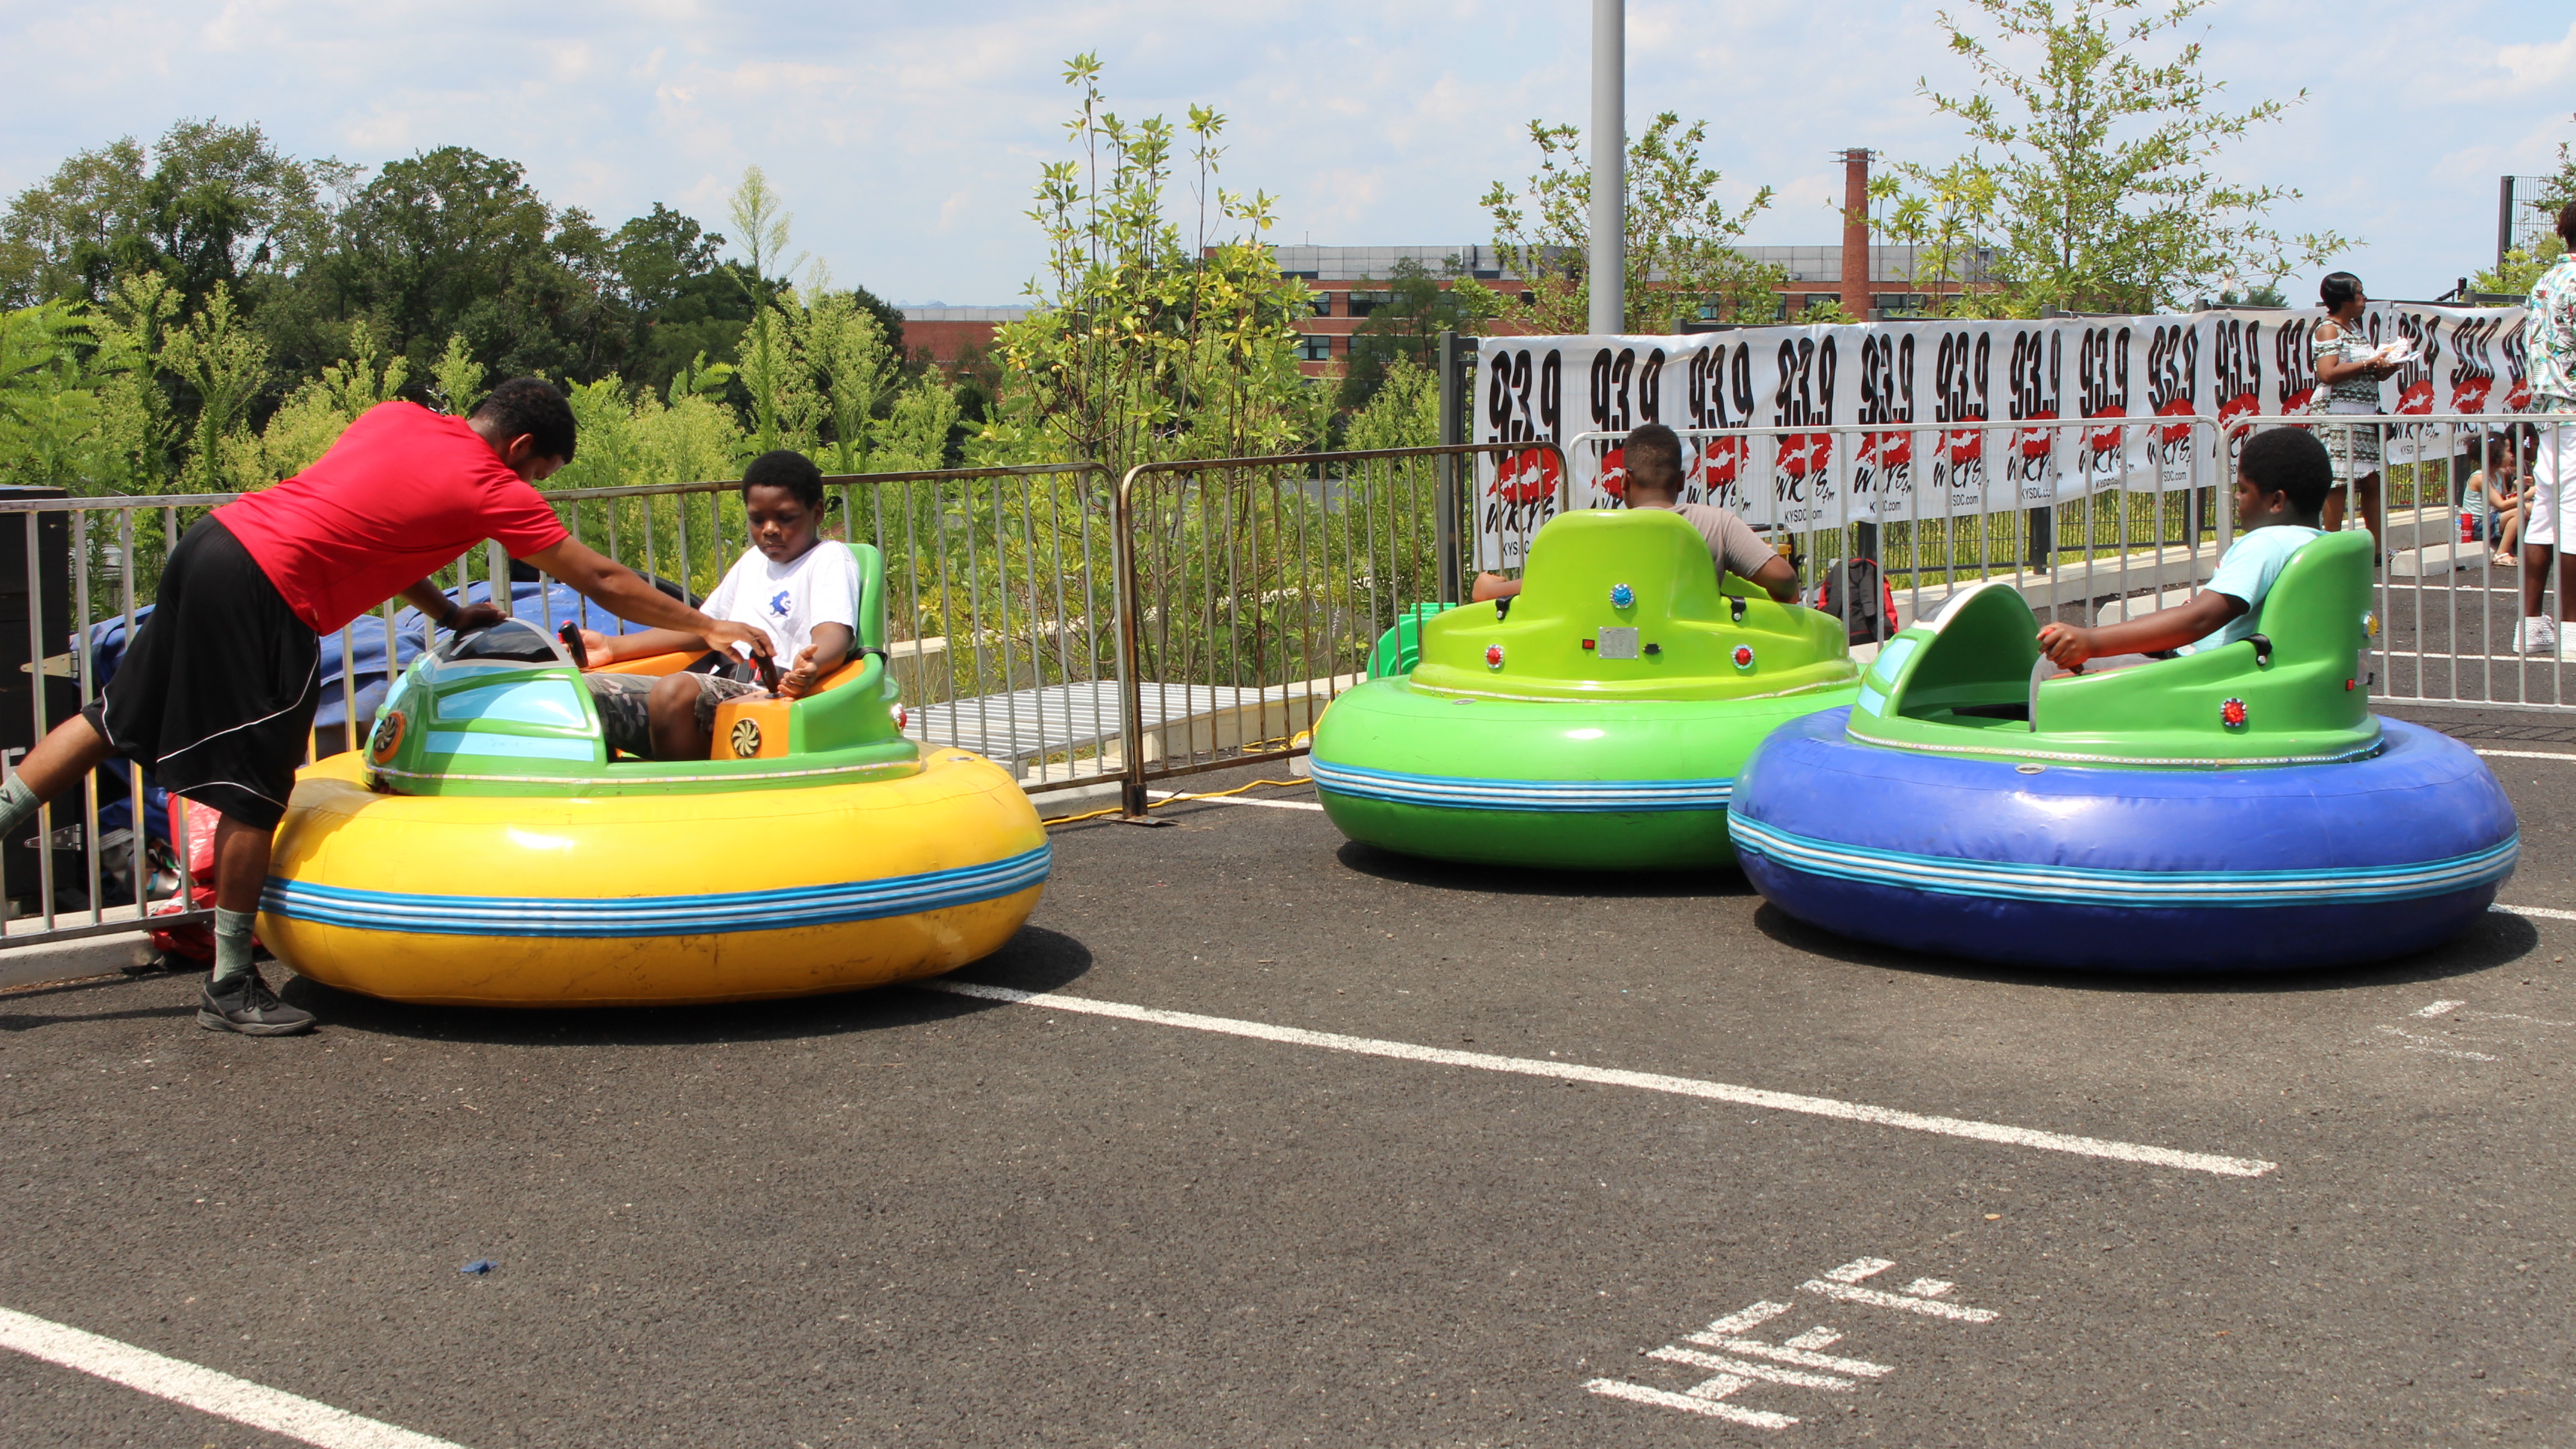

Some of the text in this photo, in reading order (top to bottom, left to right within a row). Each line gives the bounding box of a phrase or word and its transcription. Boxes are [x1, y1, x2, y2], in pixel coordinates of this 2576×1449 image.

[1935, 331, 1990, 431] 93.9
[2009, 329, 2062, 420] 93.9
[2079, 326, 2131, 419] 93.9
[2147, 323, 2199, 415] 93.9
[2214, 319, 2261, 410] 93.9
